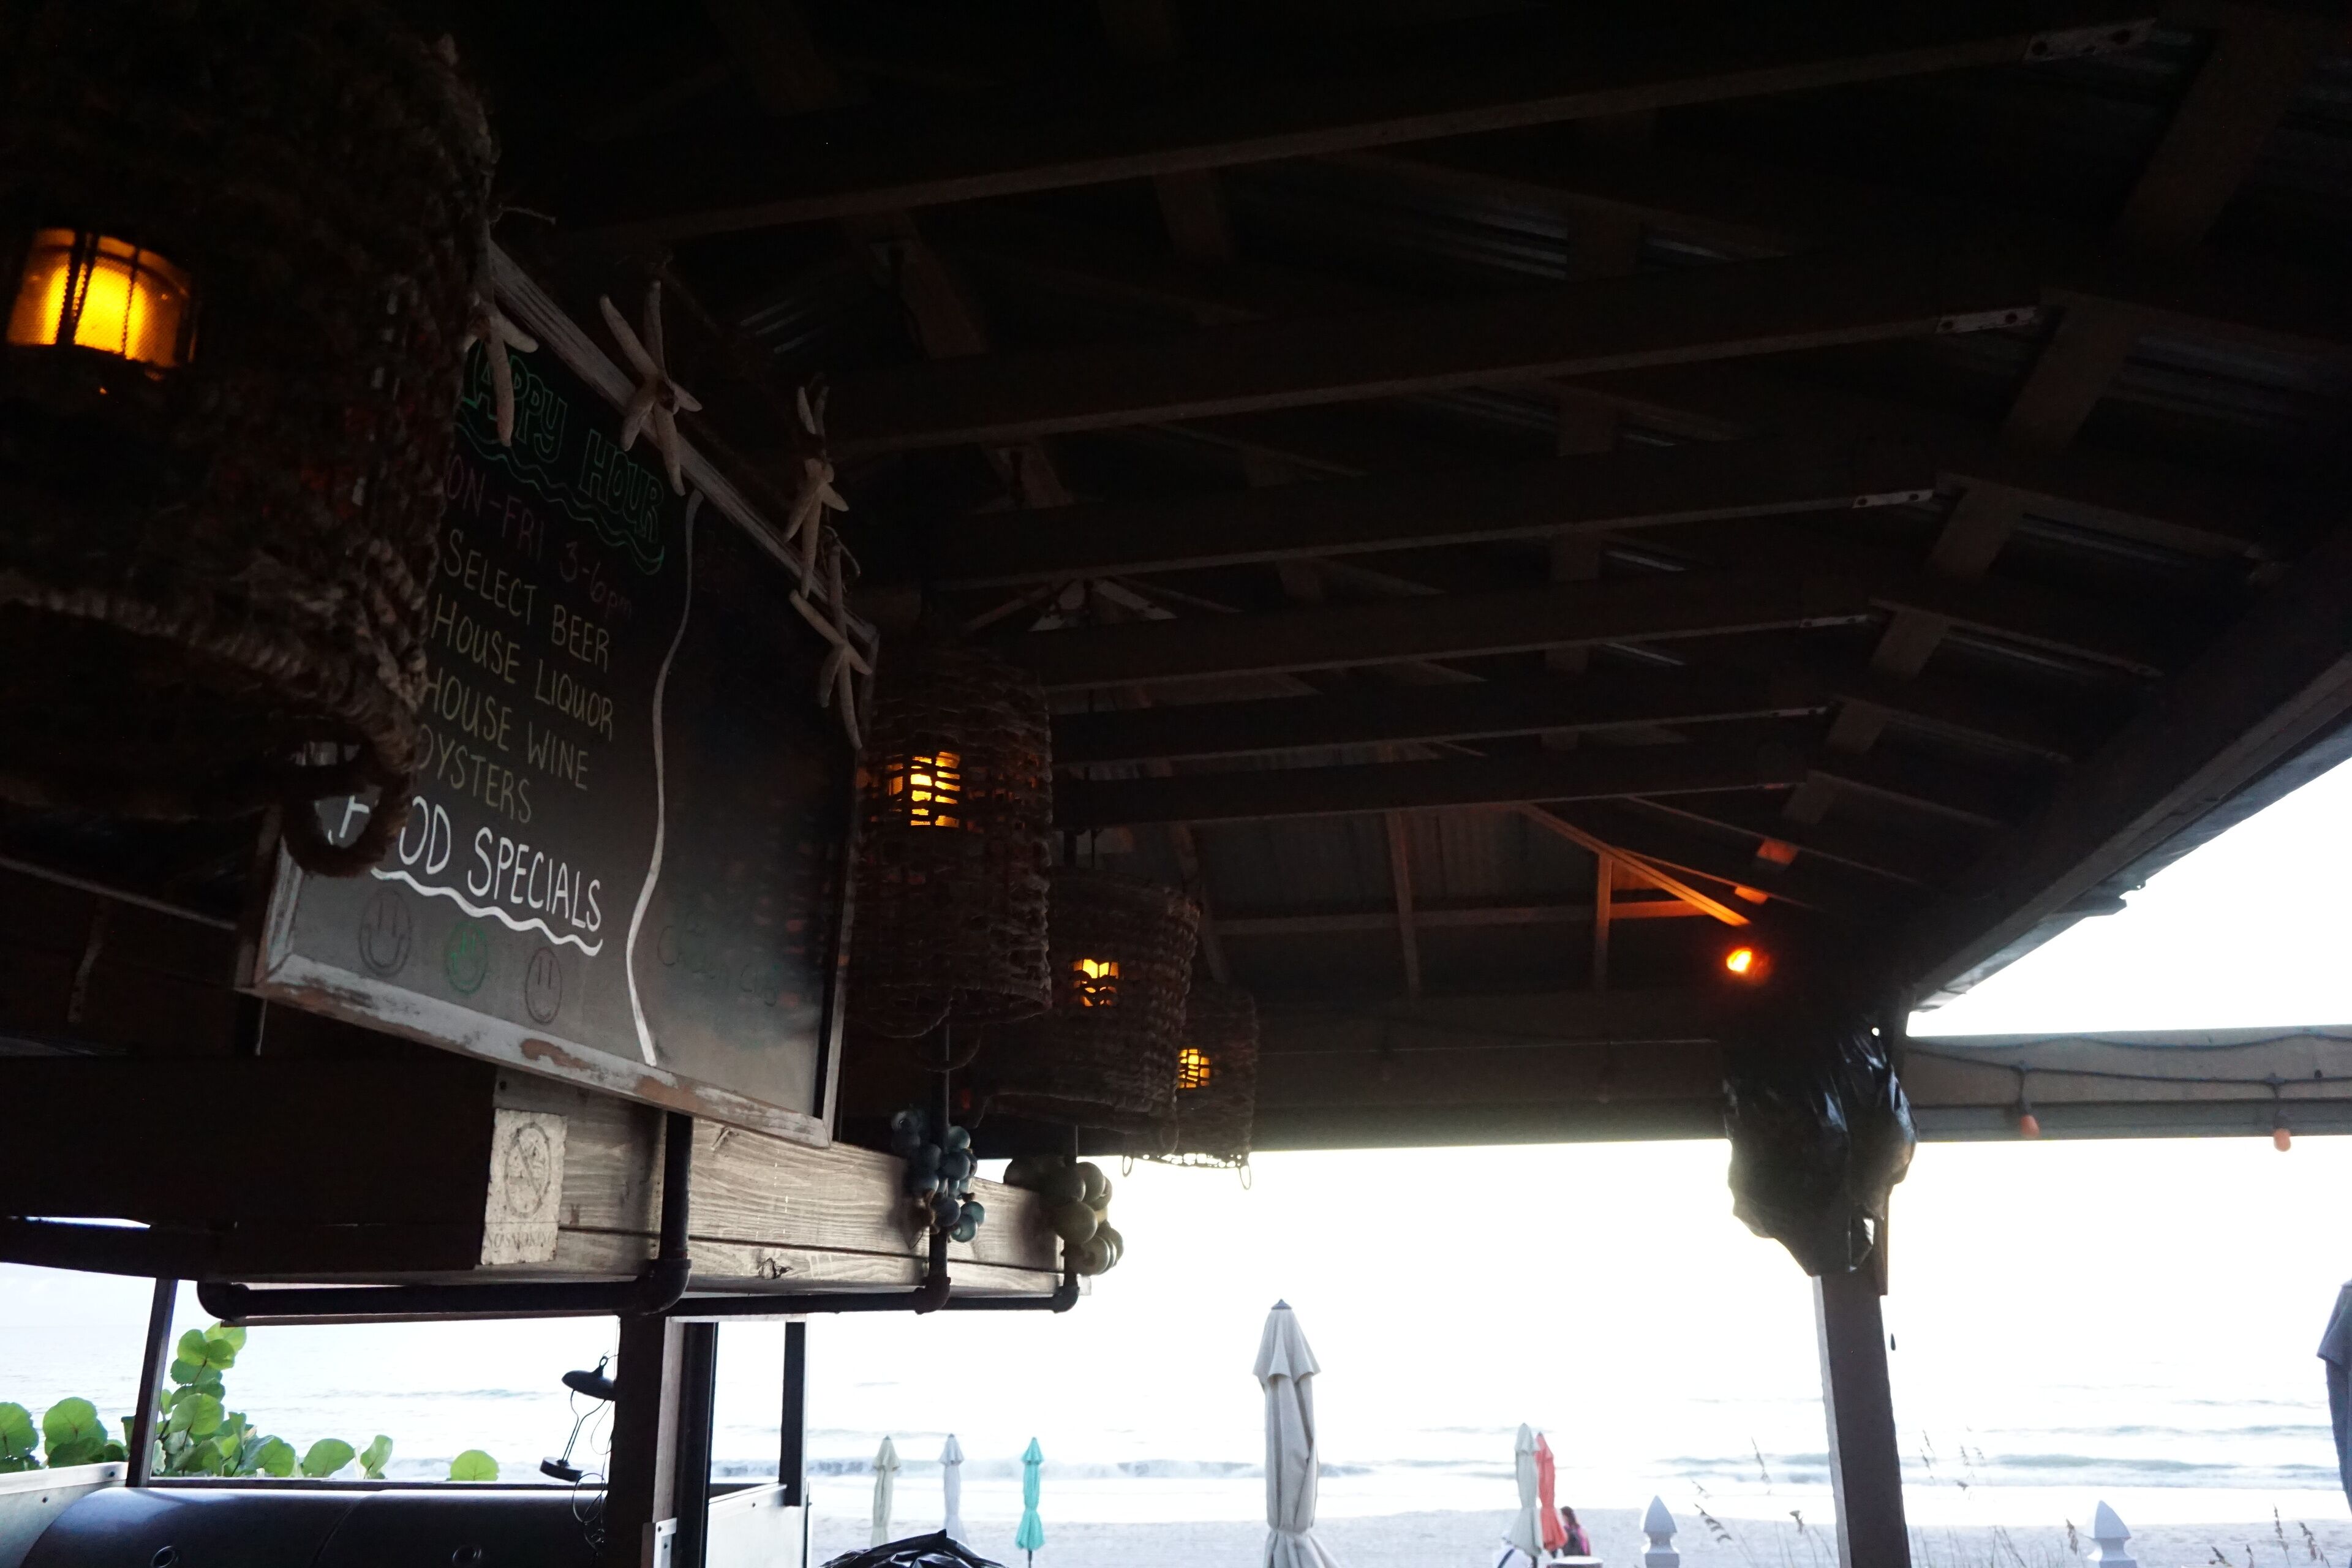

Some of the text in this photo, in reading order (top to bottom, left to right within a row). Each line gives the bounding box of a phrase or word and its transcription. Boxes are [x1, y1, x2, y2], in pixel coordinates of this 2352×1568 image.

[447, 453, 545, 562] ON-FRI
[578, 428, 664, 543] HOUR
[443, 528, 610, 674] SELECT BEER
[428, 666, 589, 791] HOUSE WINE
[431, 592, 613, 742] HOUSE LIQUOR
[418, 723, 532, 823] OYSTERS
[339, 794, 602, 932] FOD SPECIALS
